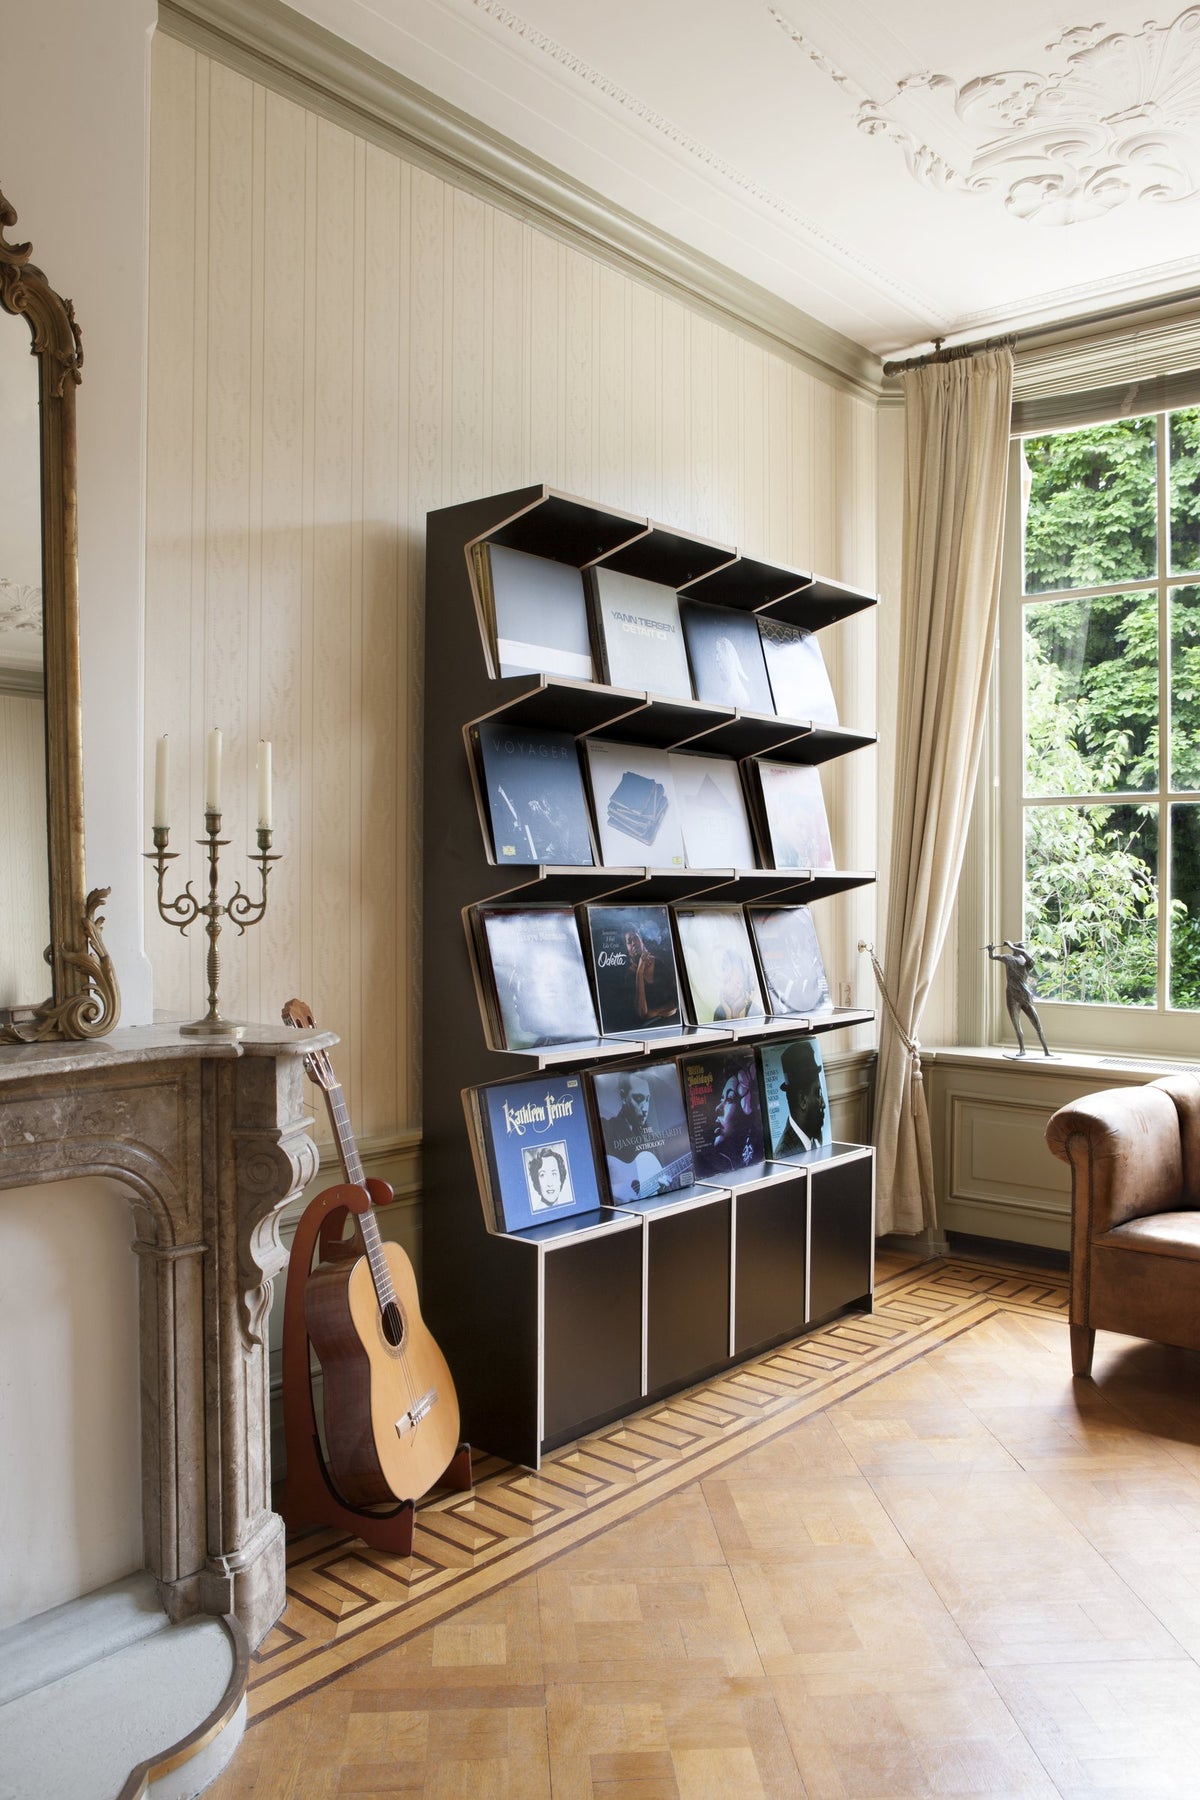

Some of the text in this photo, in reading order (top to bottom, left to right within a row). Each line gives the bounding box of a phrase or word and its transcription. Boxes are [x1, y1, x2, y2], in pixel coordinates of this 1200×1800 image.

[611, 610, 675, 633] YANN TIERSEN
[492, 739, 569, 760] VOYAGER
[598, 951, 627, 968] Odetta
[502, 1091, 574, 1136] Kathleen Ferrier
[613, 1127, 683, 1150] DJANGO REINHARDT
[642, 1126, 654, 1134] THE
[635, 1139, 666, 1151] ANTHOLOGY
